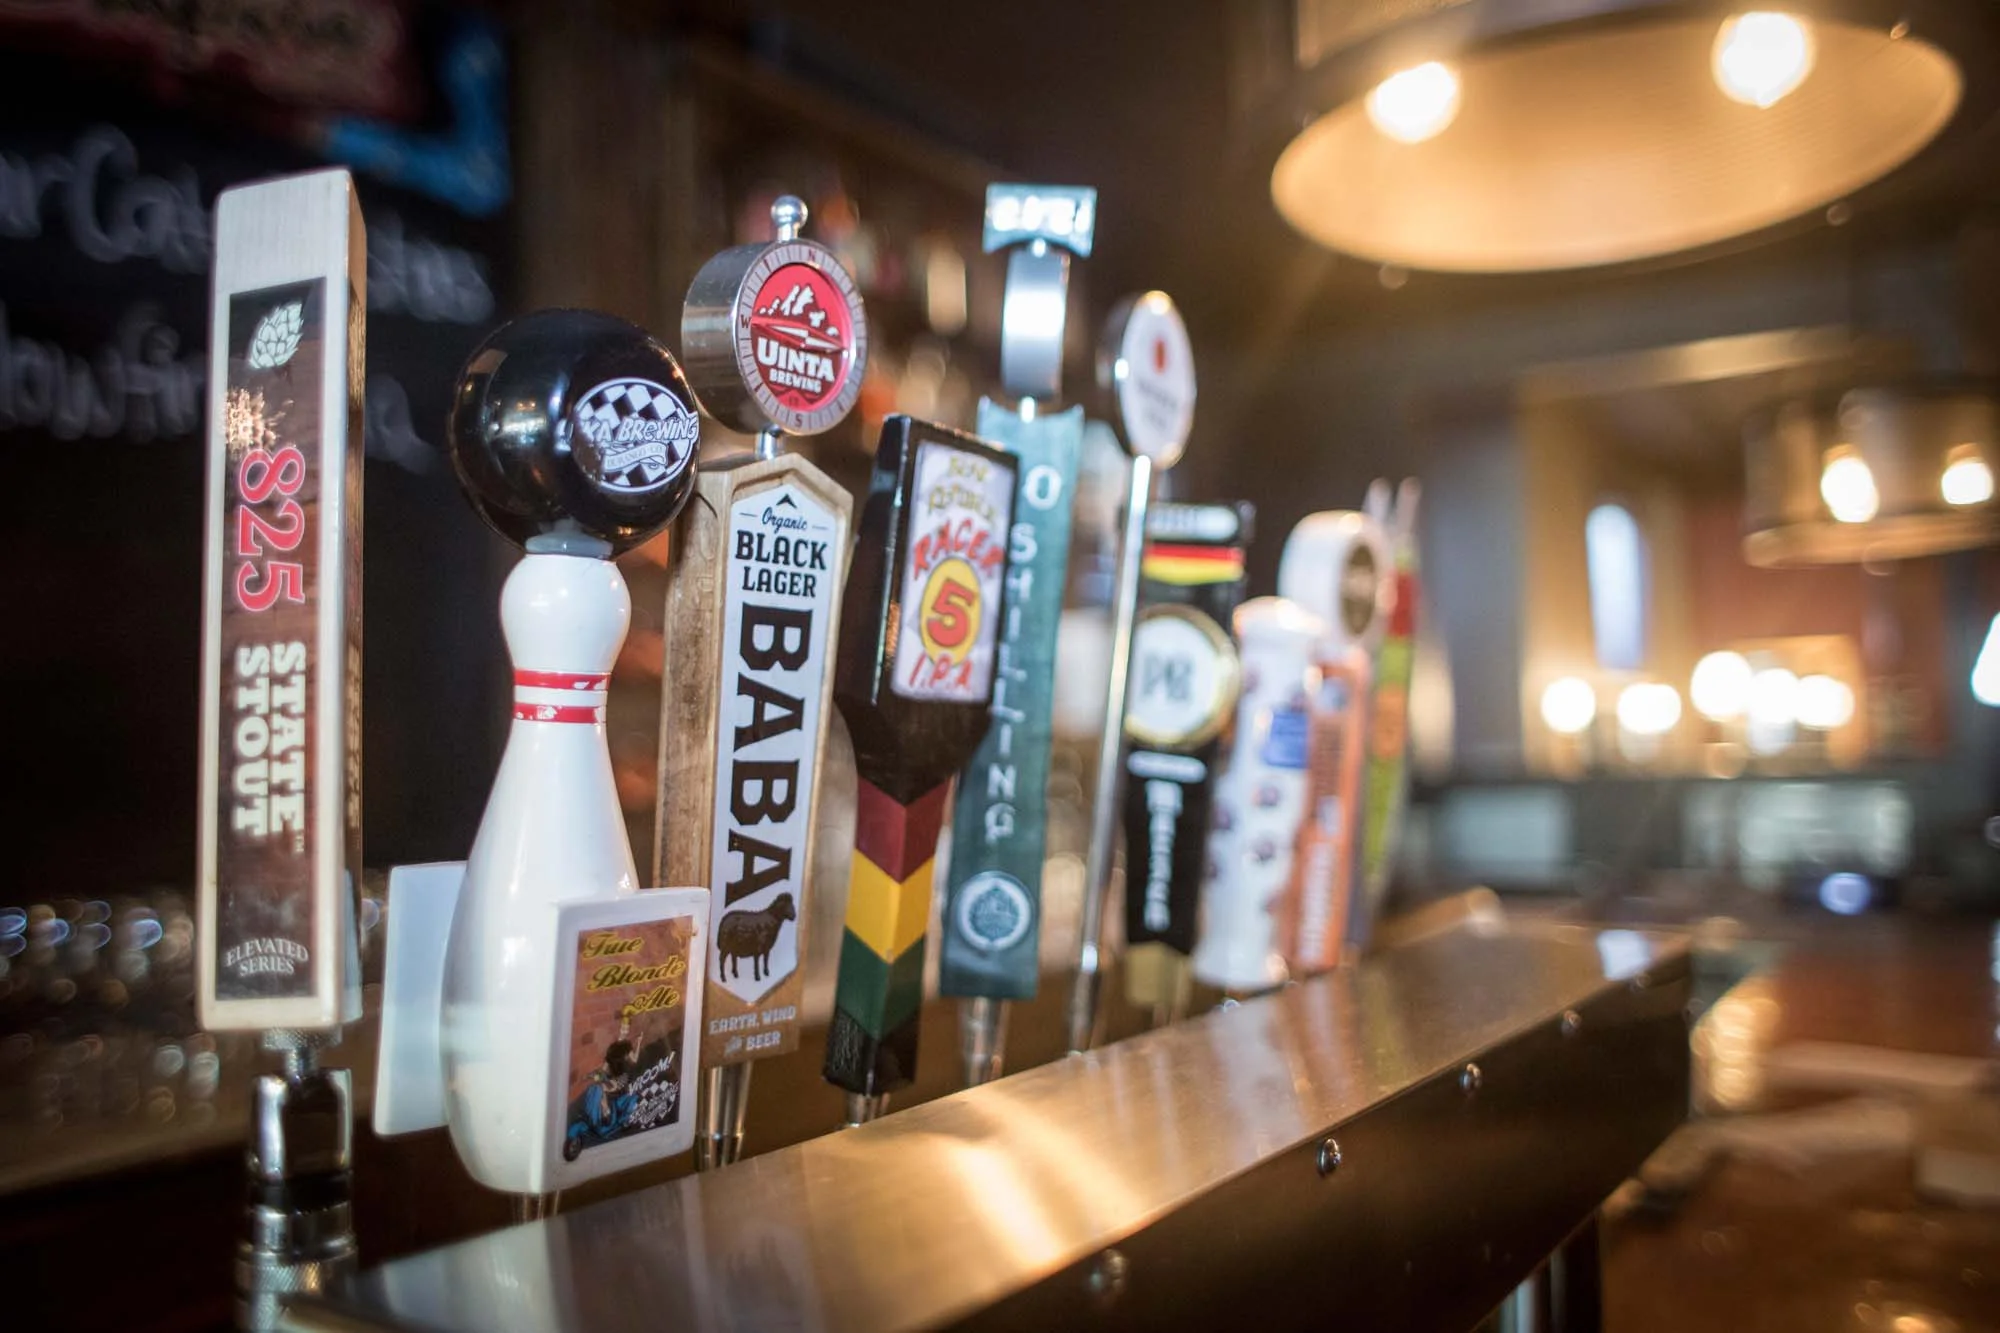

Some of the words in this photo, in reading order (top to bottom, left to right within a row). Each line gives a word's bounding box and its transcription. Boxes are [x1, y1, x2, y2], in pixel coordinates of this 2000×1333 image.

[757, 336, 835, 383] UINTA
[769, 368, 822, 394] BREWING
[236, 446, 306, 613] 825
[762, 506, 808, 534] Organic
[735, 529, 828, 570] BLACK
[913, 517, 1005, 582] RACER
[742, 566, 817, 598] LAGER
[926, 577, 978, 648] 5
[984, 522, 1039, 843] SHILLING
[234, 642, 271, 837] STOUT
[271, 641, 306, 833] STATE
[724, 601, 814, 909] BABA
[225, 937, 309, 967] ELEVATED
[583, 932, 643, 959] True
[239, 955, 294, 977] SERIES
[587, 955, 685, 991] Blonde
[633, 985, 679, 1012] Ale
[761, 1005, 796, 1025] WIND
[746, 1031, 781, 1051] BEER
